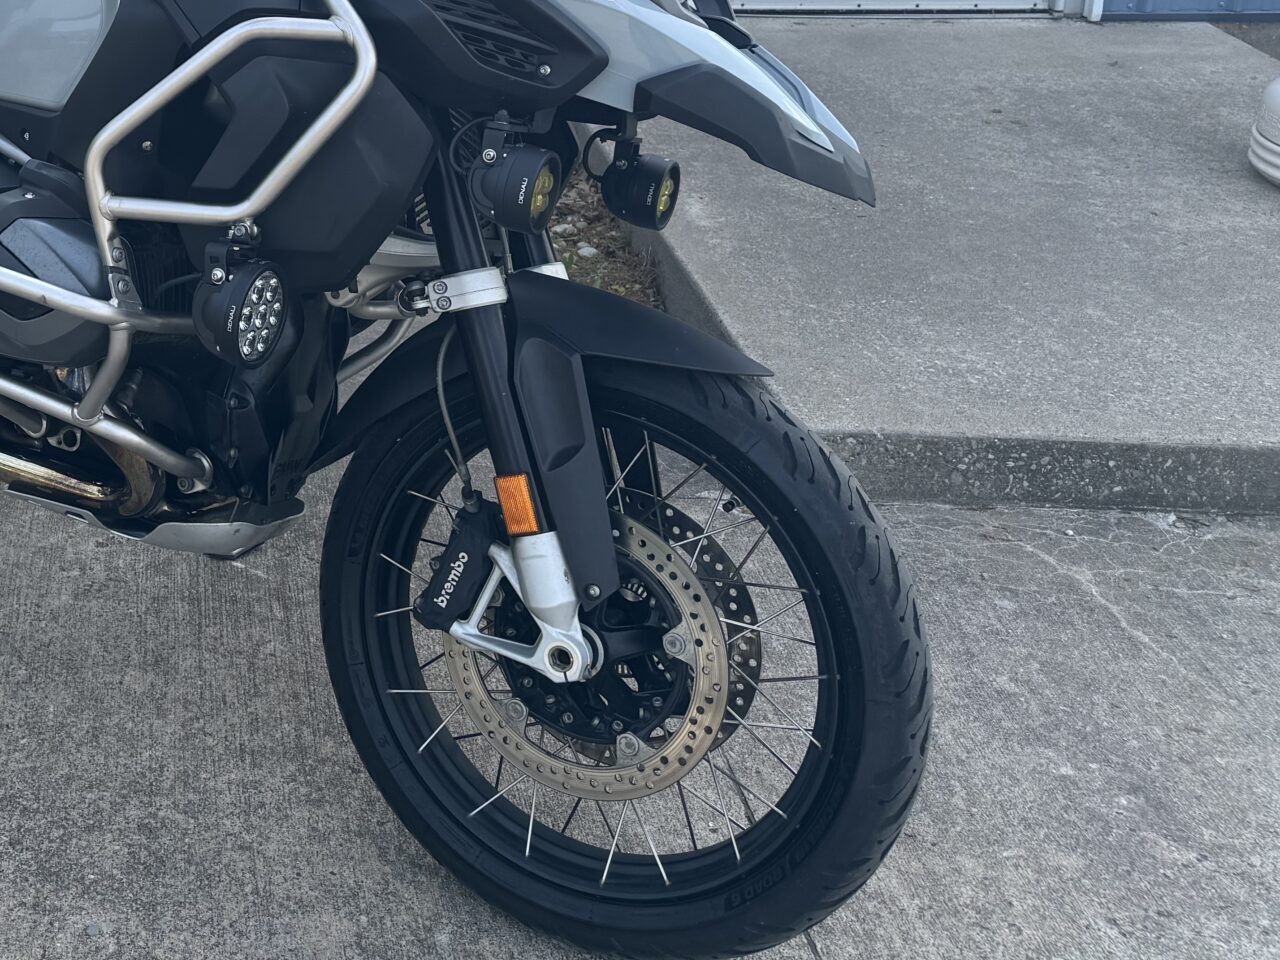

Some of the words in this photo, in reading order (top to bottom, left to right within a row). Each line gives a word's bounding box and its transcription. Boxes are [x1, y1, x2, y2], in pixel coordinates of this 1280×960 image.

[518, 177, 528, 205] DENALI
[227, 305, 236, 332] DENALI
[433, 551, 469, 609] brembo
